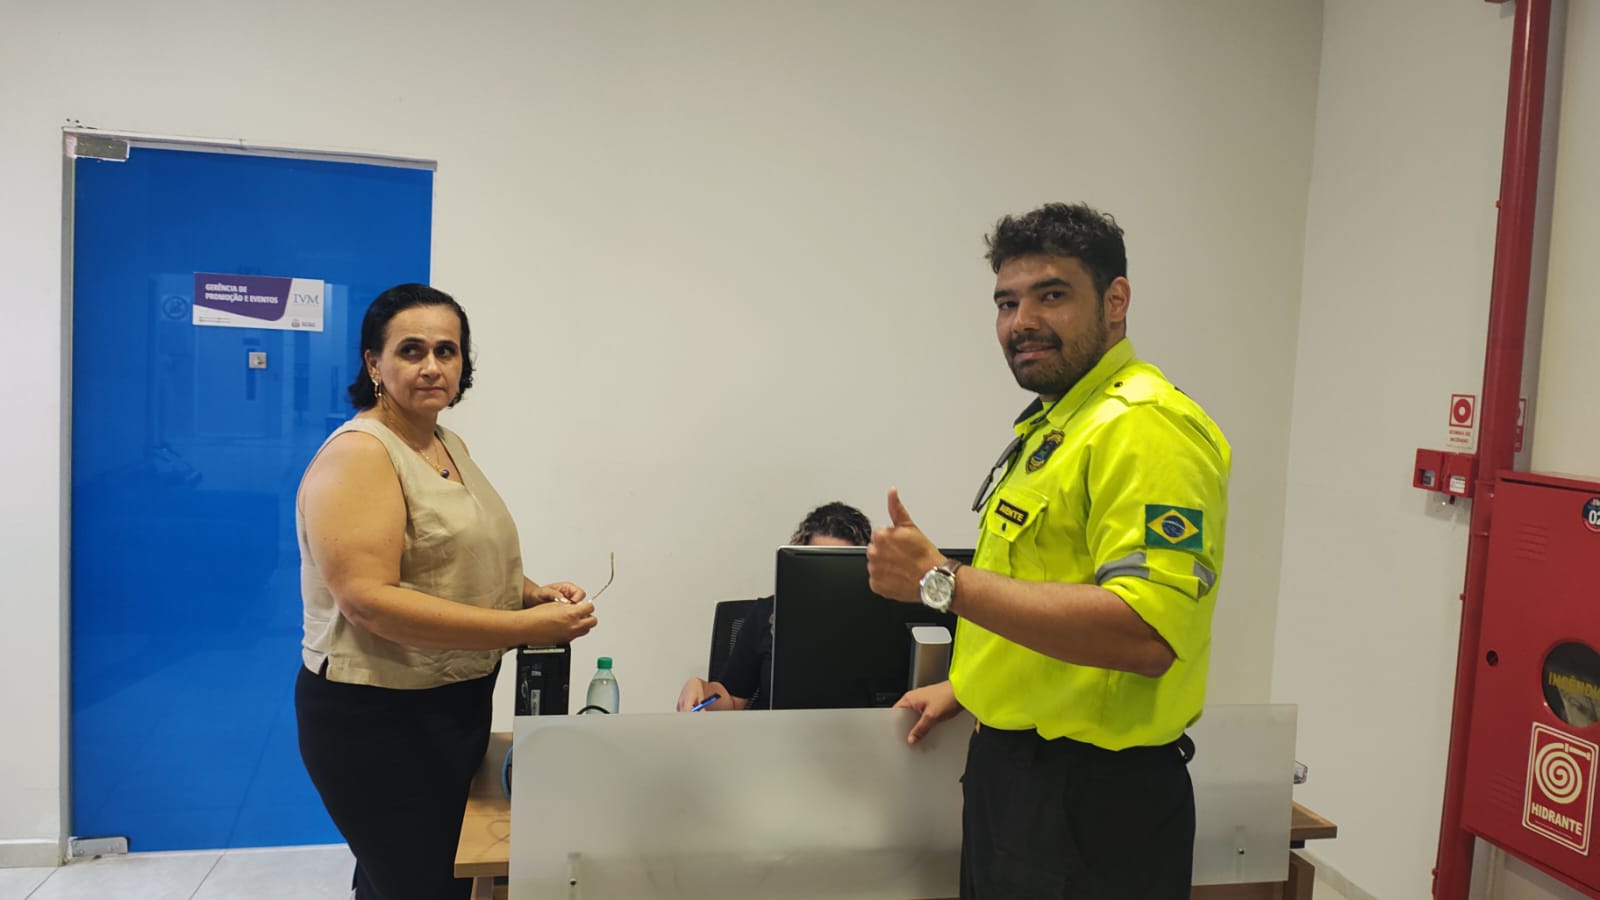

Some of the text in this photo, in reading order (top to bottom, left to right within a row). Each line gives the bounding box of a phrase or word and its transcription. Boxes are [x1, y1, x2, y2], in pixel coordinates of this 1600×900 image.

[205, 283, 248, 293] GERÊNCIA DE
[205, 292, 243, 303] PROMOÇÃO
[250, 295, 279, 304] EVENTOS
[293, 293, 320, 305] IVM
[1531, 802, 1584, 836] HIDRANTE
